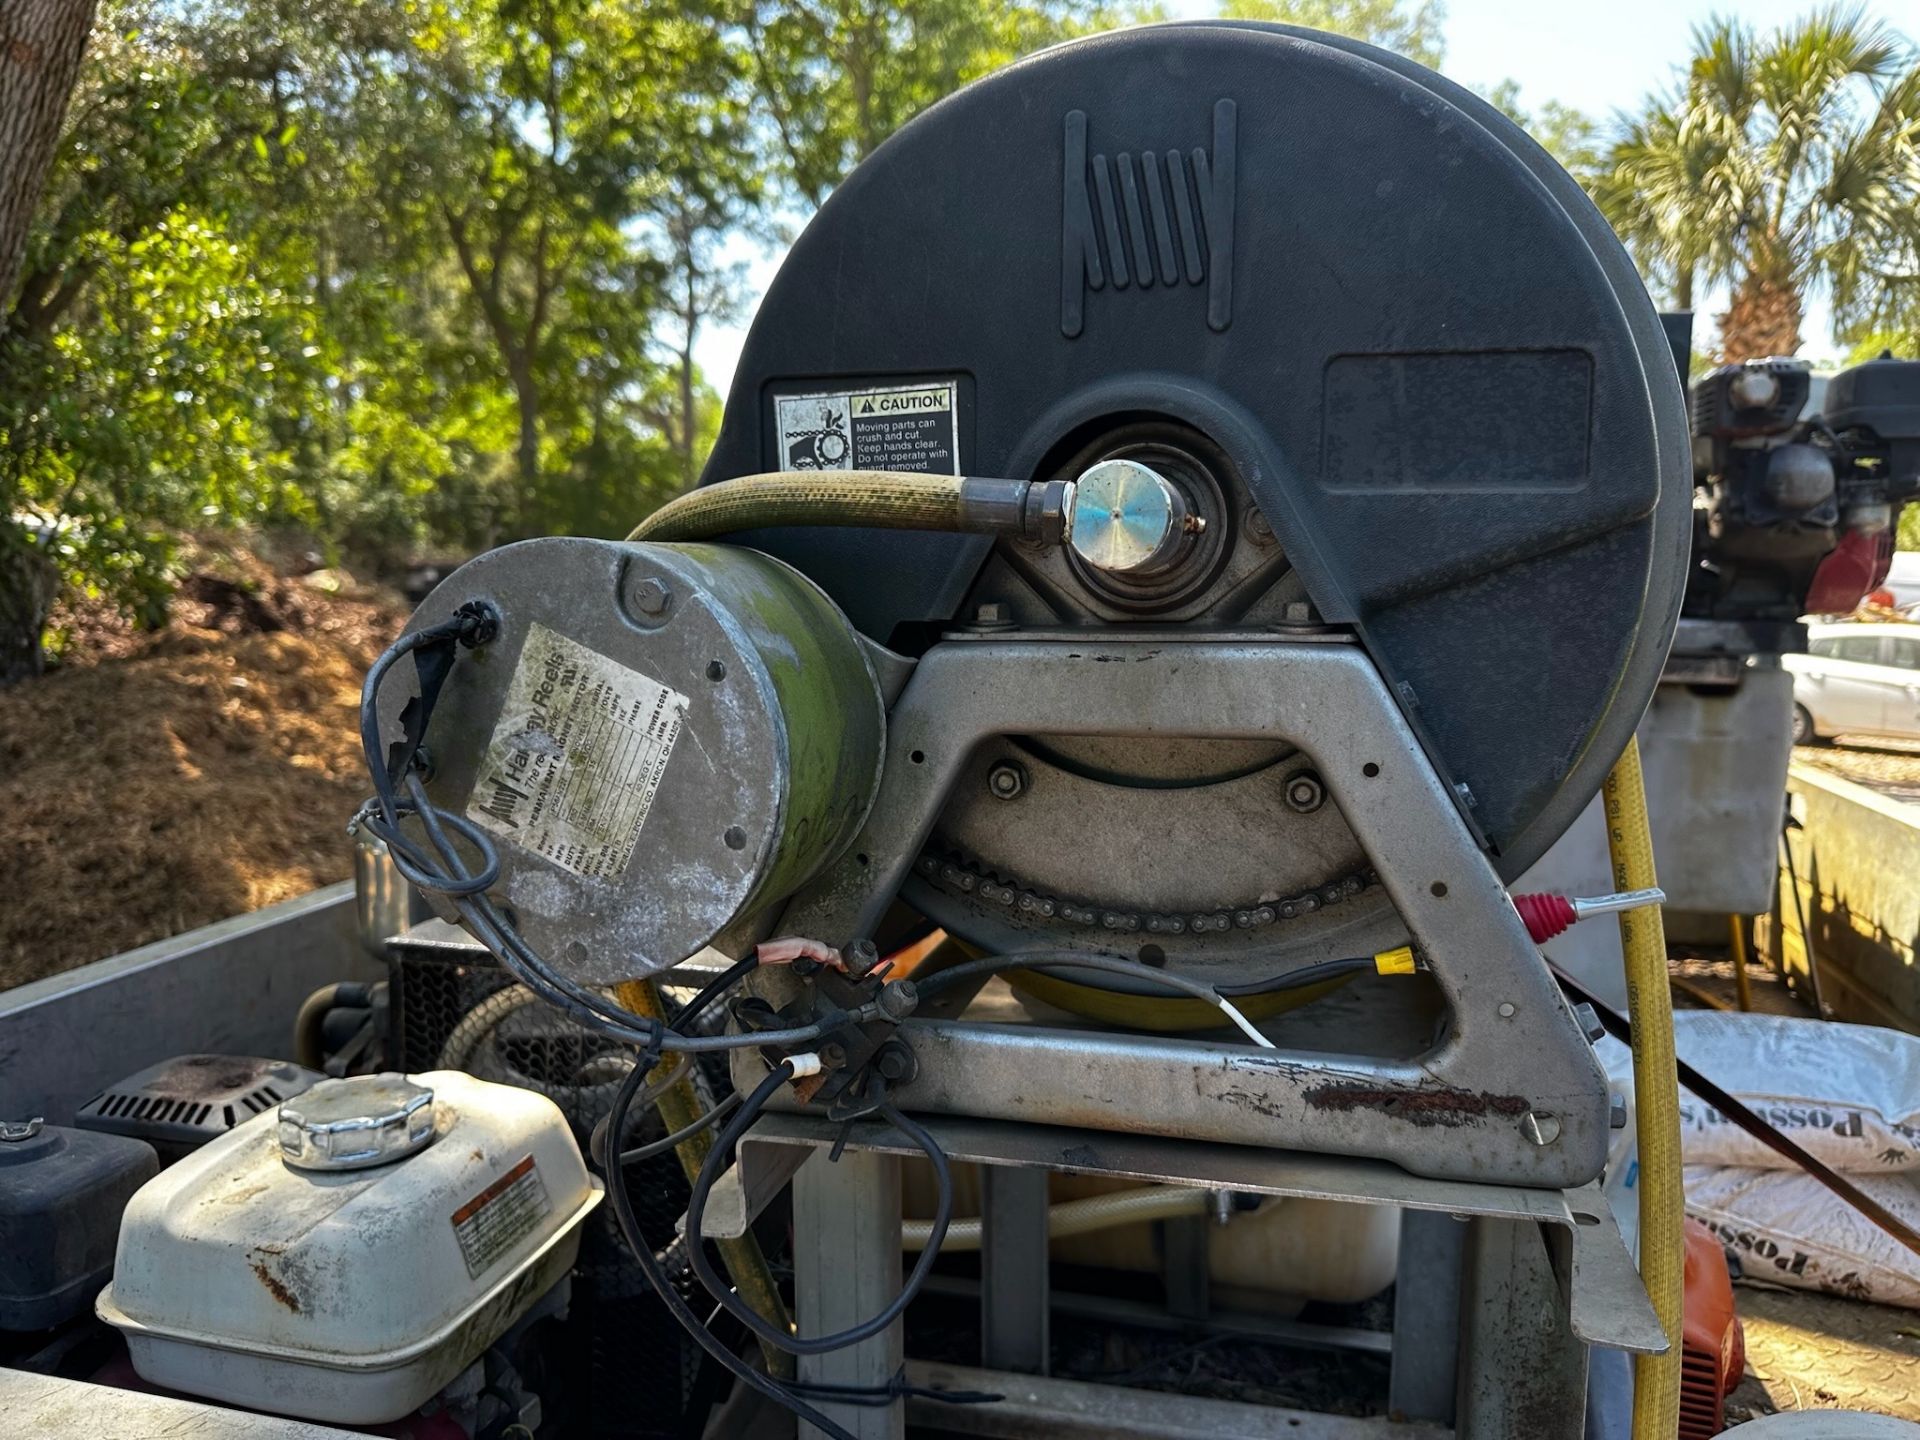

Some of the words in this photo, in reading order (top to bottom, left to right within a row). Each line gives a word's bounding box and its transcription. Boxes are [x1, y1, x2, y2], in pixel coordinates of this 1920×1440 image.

[880, 396, 943, 411] CAUTION
[856, 423, 889, 433] Moving
[892, 421, 915, 432] parts
[918, 420, 935, 428] can
[857, 433, 882, 443] crush
[885, 431, 902, 441] and
[905, 431, 922, 439] cut.
[857, 445, 881, 454] Keep
[884, 442, 912, 450] hands
[915, 440, 940, 449] clear.
[858, 454, 870, 463] Do
[874, 453, 888, 462] not
[891, 451, 926, 463] operate
[929, 450, 948, 458] with
[887, 461, 930, 471] removed.
[599, 685, 614, 711] VOLTS
[609, 693, 621, 716] AMPS
[505, 706, 548, 783] Haay
[530, 650, 566, 708] Reels
[627, 699, 642, 725] PHASE
[647, 709, 661, 735] POWER
[657, 688, 669, 709] CODE
[527, 762, 558, 827] PERMANENT
[570, 674, 590, 713] MOTOR
[525, 767, 540, 789] The
[630, 803, 648, 841] ELECTRIC
[555, 843, 566, 860] RPM
[565, 844, 576, 865] DUTY
[573, 843, 587, 870] FRAME
